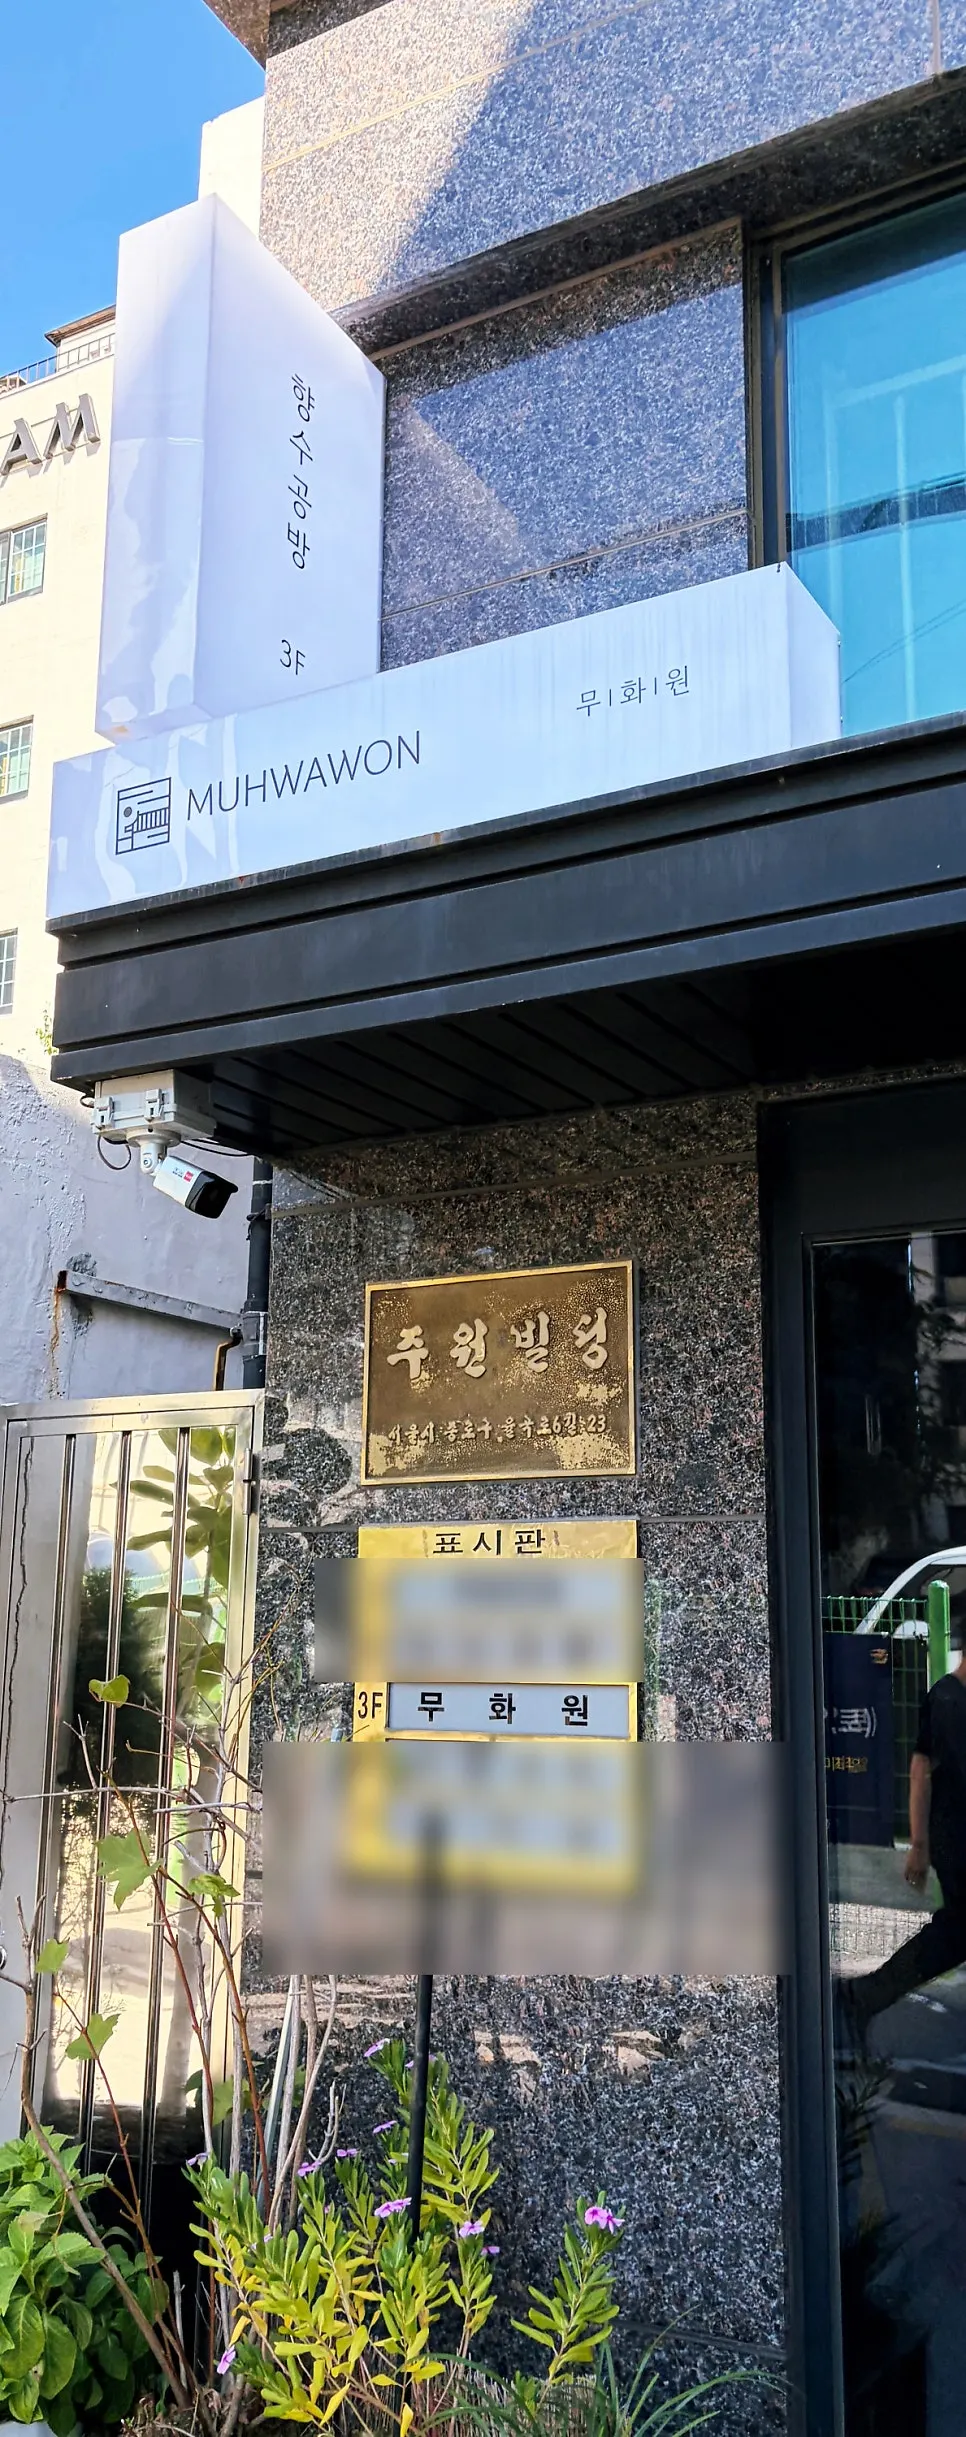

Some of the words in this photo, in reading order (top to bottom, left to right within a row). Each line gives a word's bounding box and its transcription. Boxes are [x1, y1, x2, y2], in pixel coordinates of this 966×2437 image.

[0, 393, 101, 476] AM
[287, 373, 316, 570] 향수공방
[280, 639, 306, 676] 3F
[187, 730, 420, 821] MUHWAWON
[388, 1421, 434, 1445] 서울시
[587, 1413, 606, 1433] 23
[432, 1528, 546, 1556] 표시판
[357, 1691, 383, 1720] 3F
